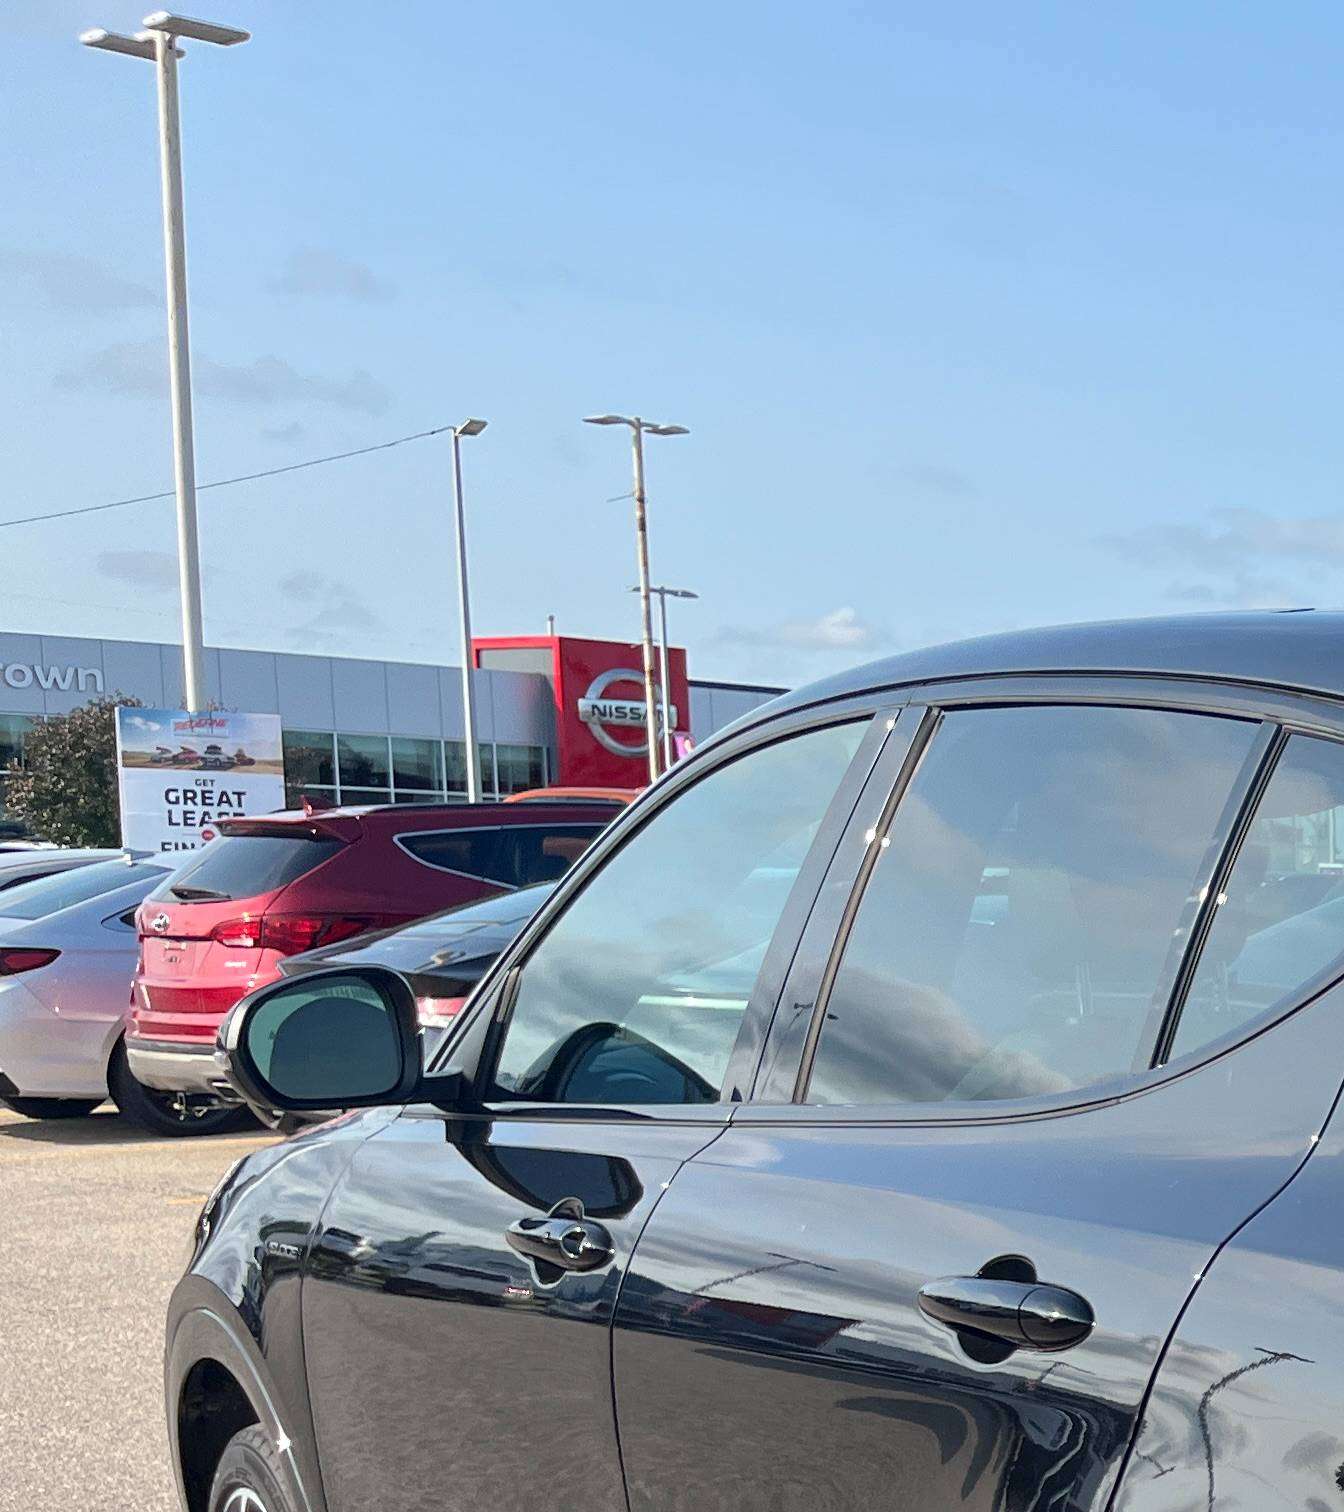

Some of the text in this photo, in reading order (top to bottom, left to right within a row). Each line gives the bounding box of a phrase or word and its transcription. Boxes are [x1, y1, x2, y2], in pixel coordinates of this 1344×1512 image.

[0, 662, 104, 692] own
[590, 703, 665, 722] NISS
[194, 778, 216, 787] GET
[164, 788, 247, 808] GREAT
[167, 809, 246, 827] LEA
